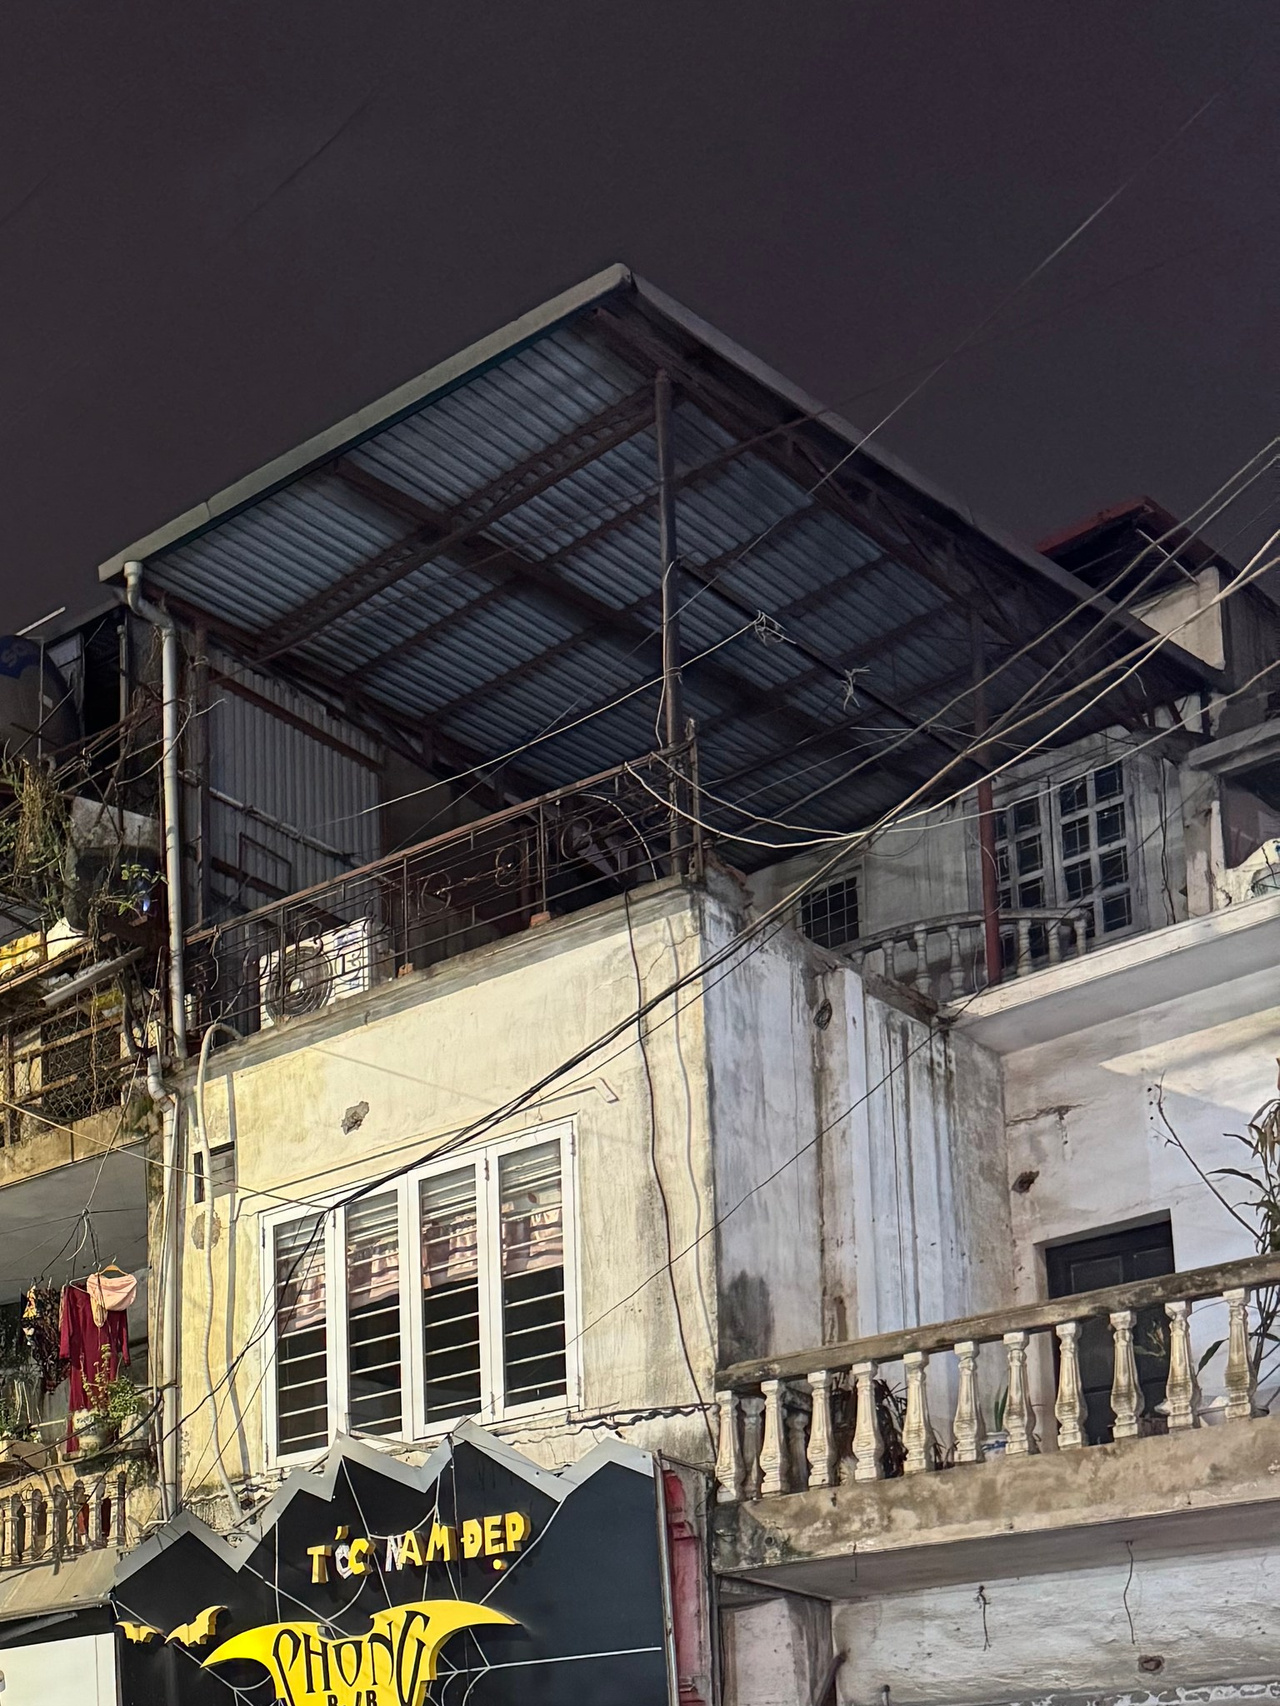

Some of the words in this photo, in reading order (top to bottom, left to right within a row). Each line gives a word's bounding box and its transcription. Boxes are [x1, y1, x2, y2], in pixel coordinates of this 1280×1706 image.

[307, 1525, 374, 1583] TÓC
[385, 1523, 458, 1572] NAM
[461, 1511, 531, 1571] ĐẸP
